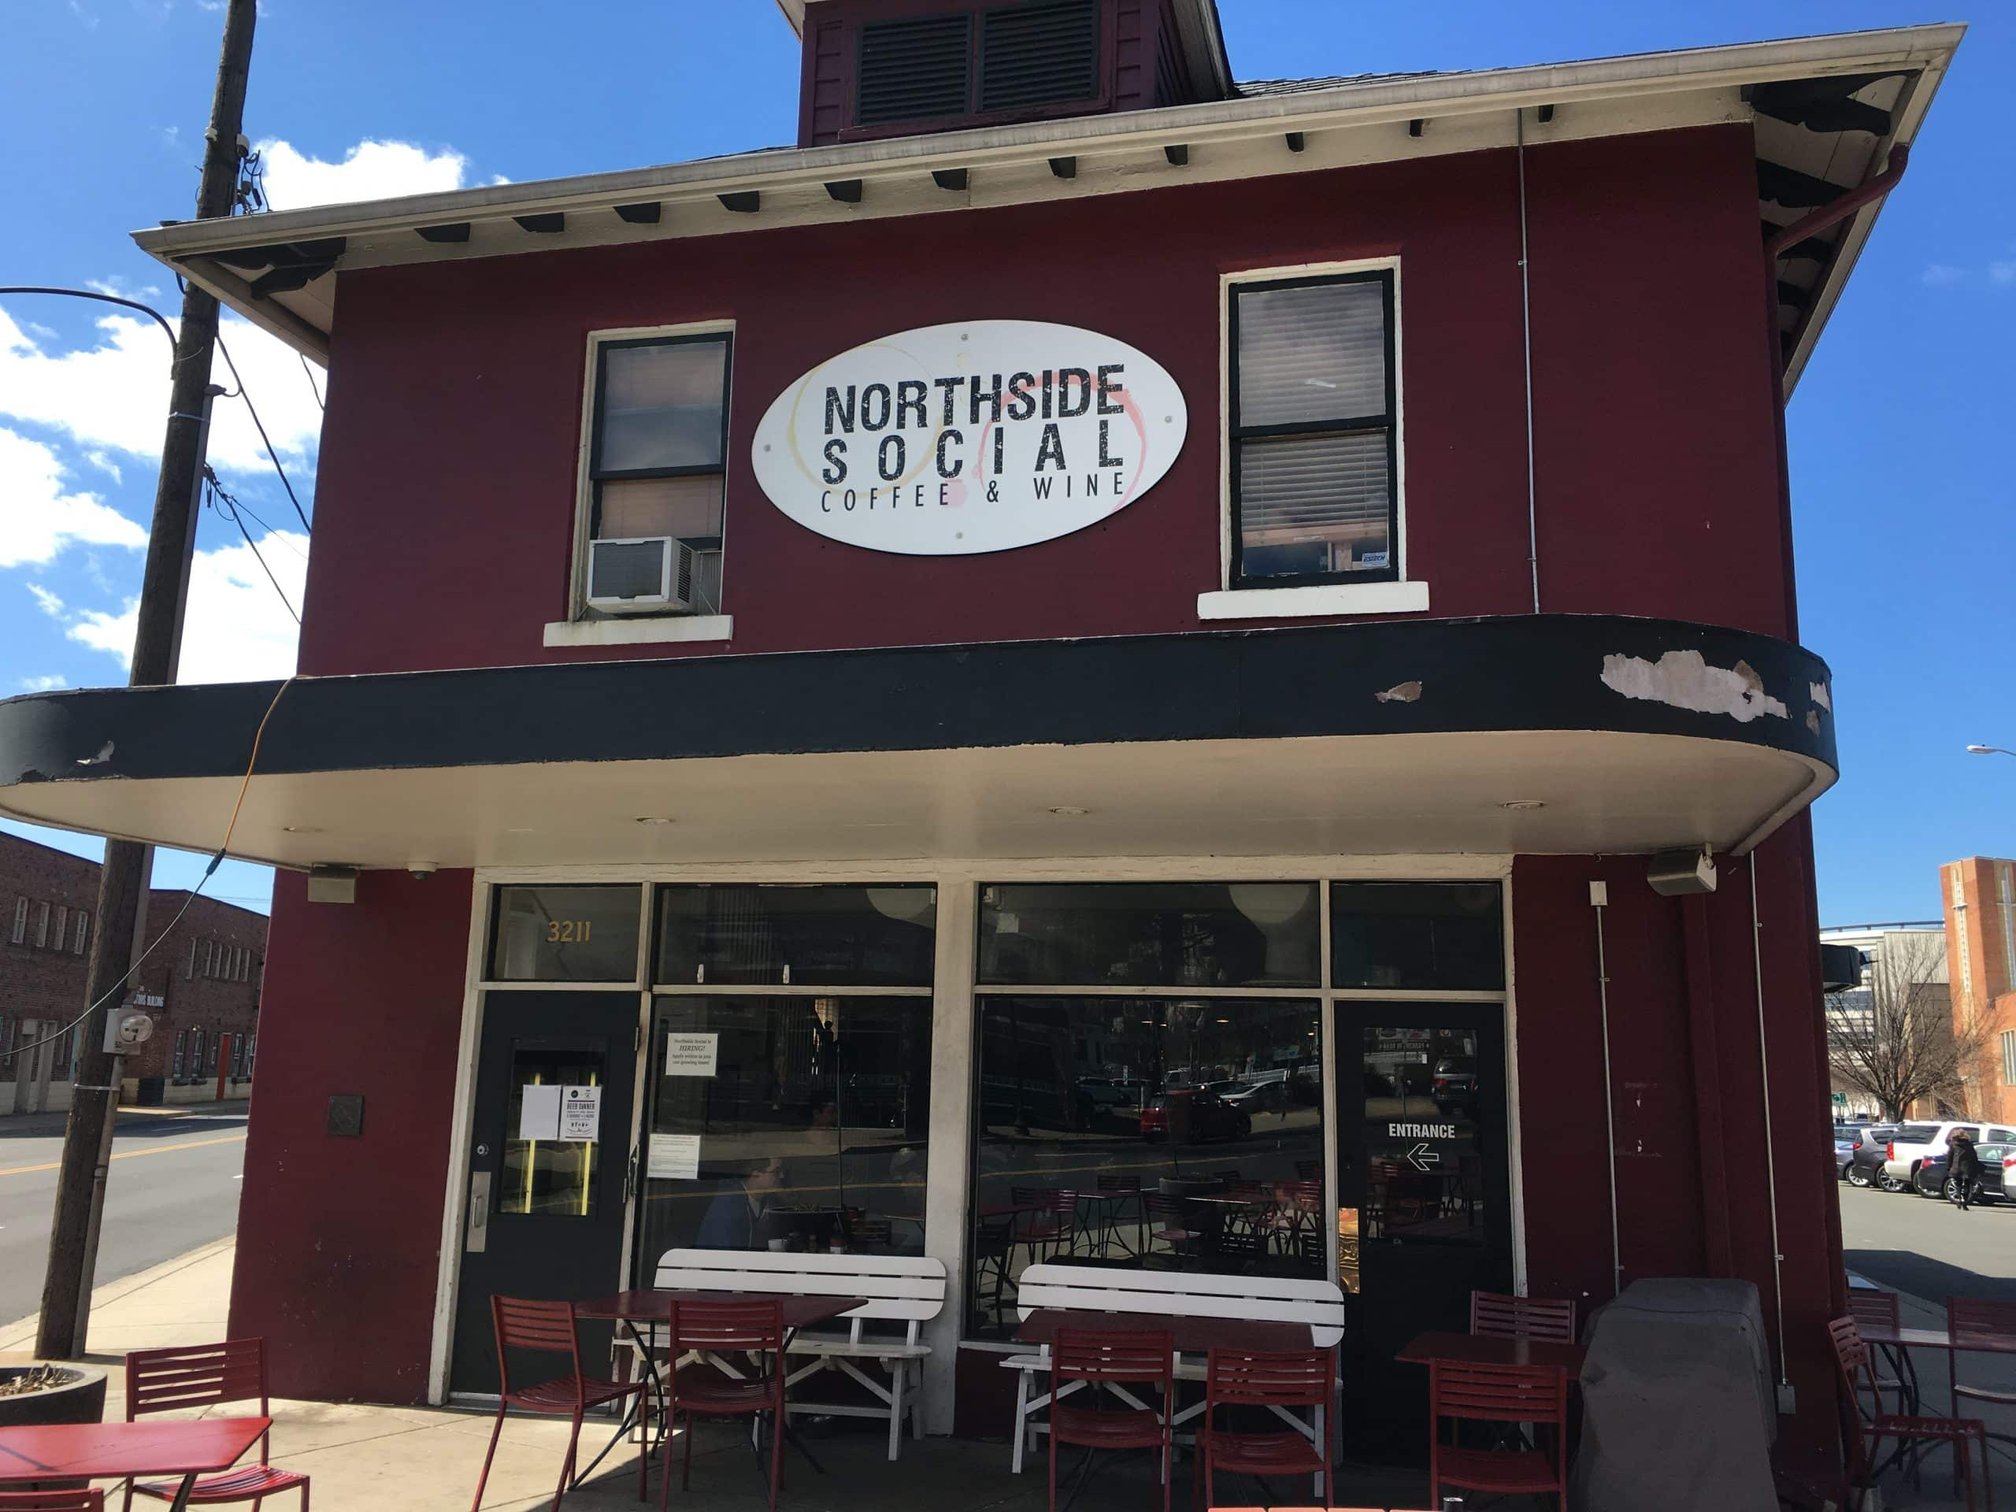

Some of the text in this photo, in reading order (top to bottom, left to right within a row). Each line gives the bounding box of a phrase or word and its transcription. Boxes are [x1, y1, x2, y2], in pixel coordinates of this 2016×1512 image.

[824, 364, 1125, 435] NORTHSIDE
[822, 420, 1124, 485] SOCIAL
[821, 472, 1124, 512] COFFEE & WINE
[547, 920, 591, 942] 3211
[1388, 1123, 1456, 1139] ENTRANCE
